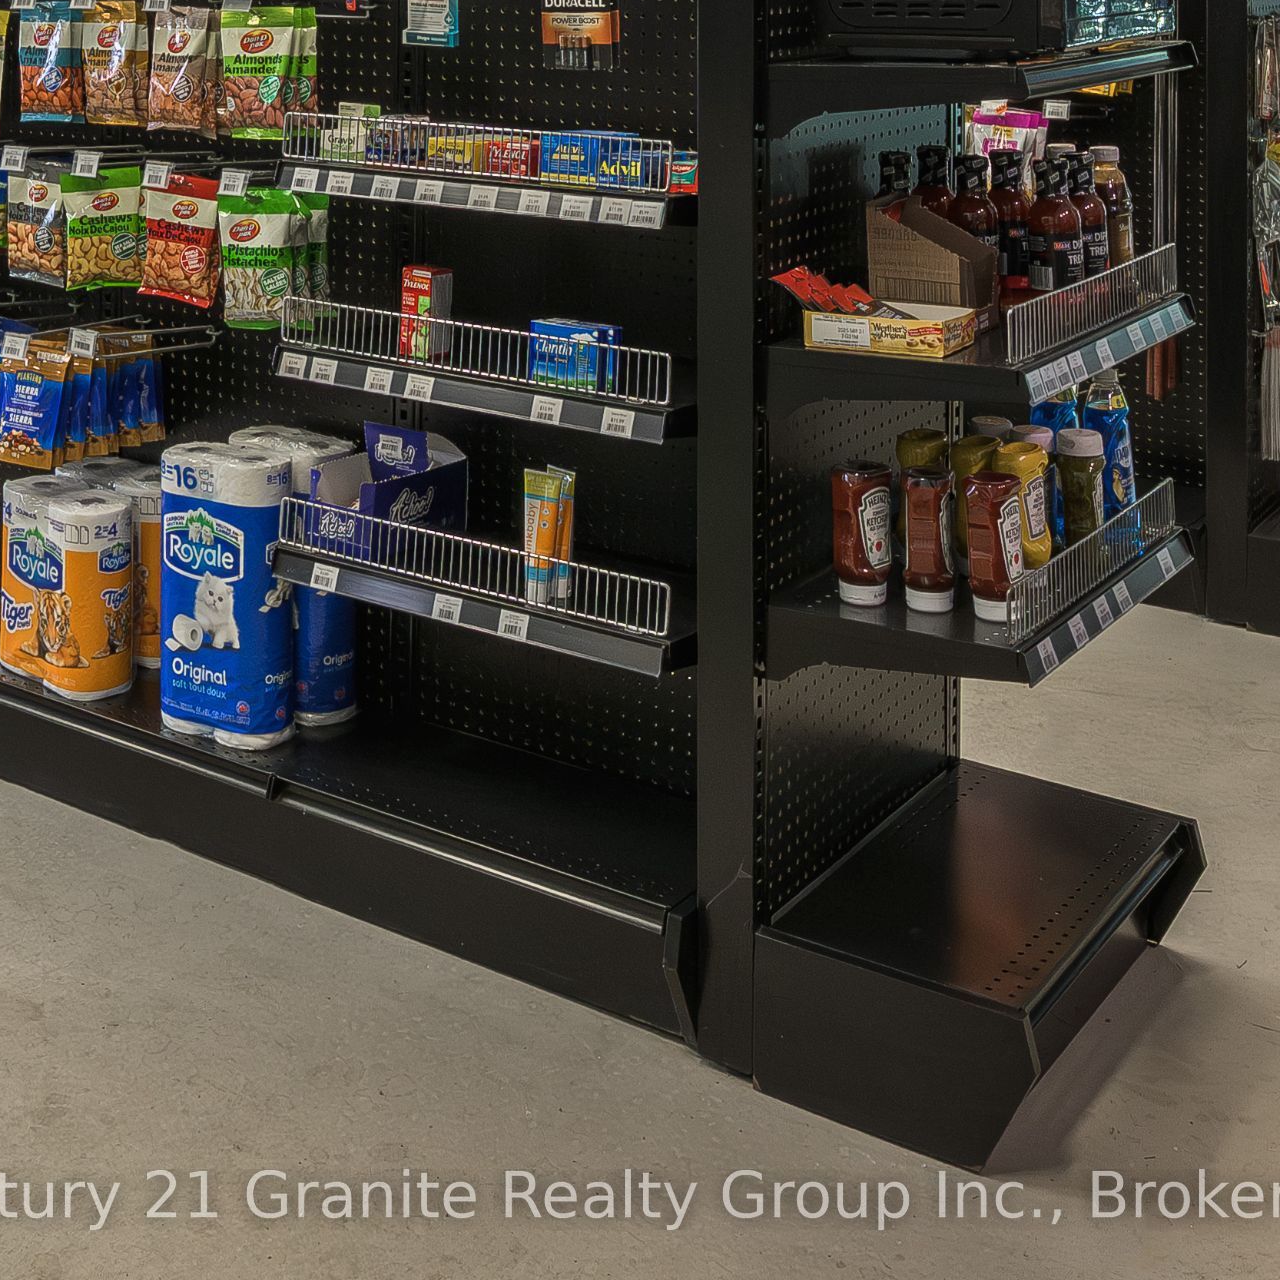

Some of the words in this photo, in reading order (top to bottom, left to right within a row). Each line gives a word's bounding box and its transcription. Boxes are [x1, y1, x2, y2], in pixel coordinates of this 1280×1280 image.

[234, 52, 283, 65] Almonds
[599, 160, 641, 177] Advil
[79, 214, 133, 227] Cashews
[157, 219, 205, 237] Cashews
[227, 244, 285, 258] Pistachios
[222, 255, 277, 267] Pistaches
[872, 323, 907, 333] Werther's
[880, 330, 907, 340] Original
[15, 384, 39, 396] SIERRA
[9, 413, 33, 426] SIERRA
[867, 495, 888, 508] HEINZ
[94, 522, 118, 537] 2=4
[170, 534, 235, 570] Royale
[13, 544, 59, 584] Royale
[103, 552, 131, 570] Royale
[2, 590, 33, 631] Tiger
[172, 657, 228, 686] Original
[172, 680, 187, 690] soft
[189, 680, 206, 694] tout
[206, 686, 227, 700] doux
